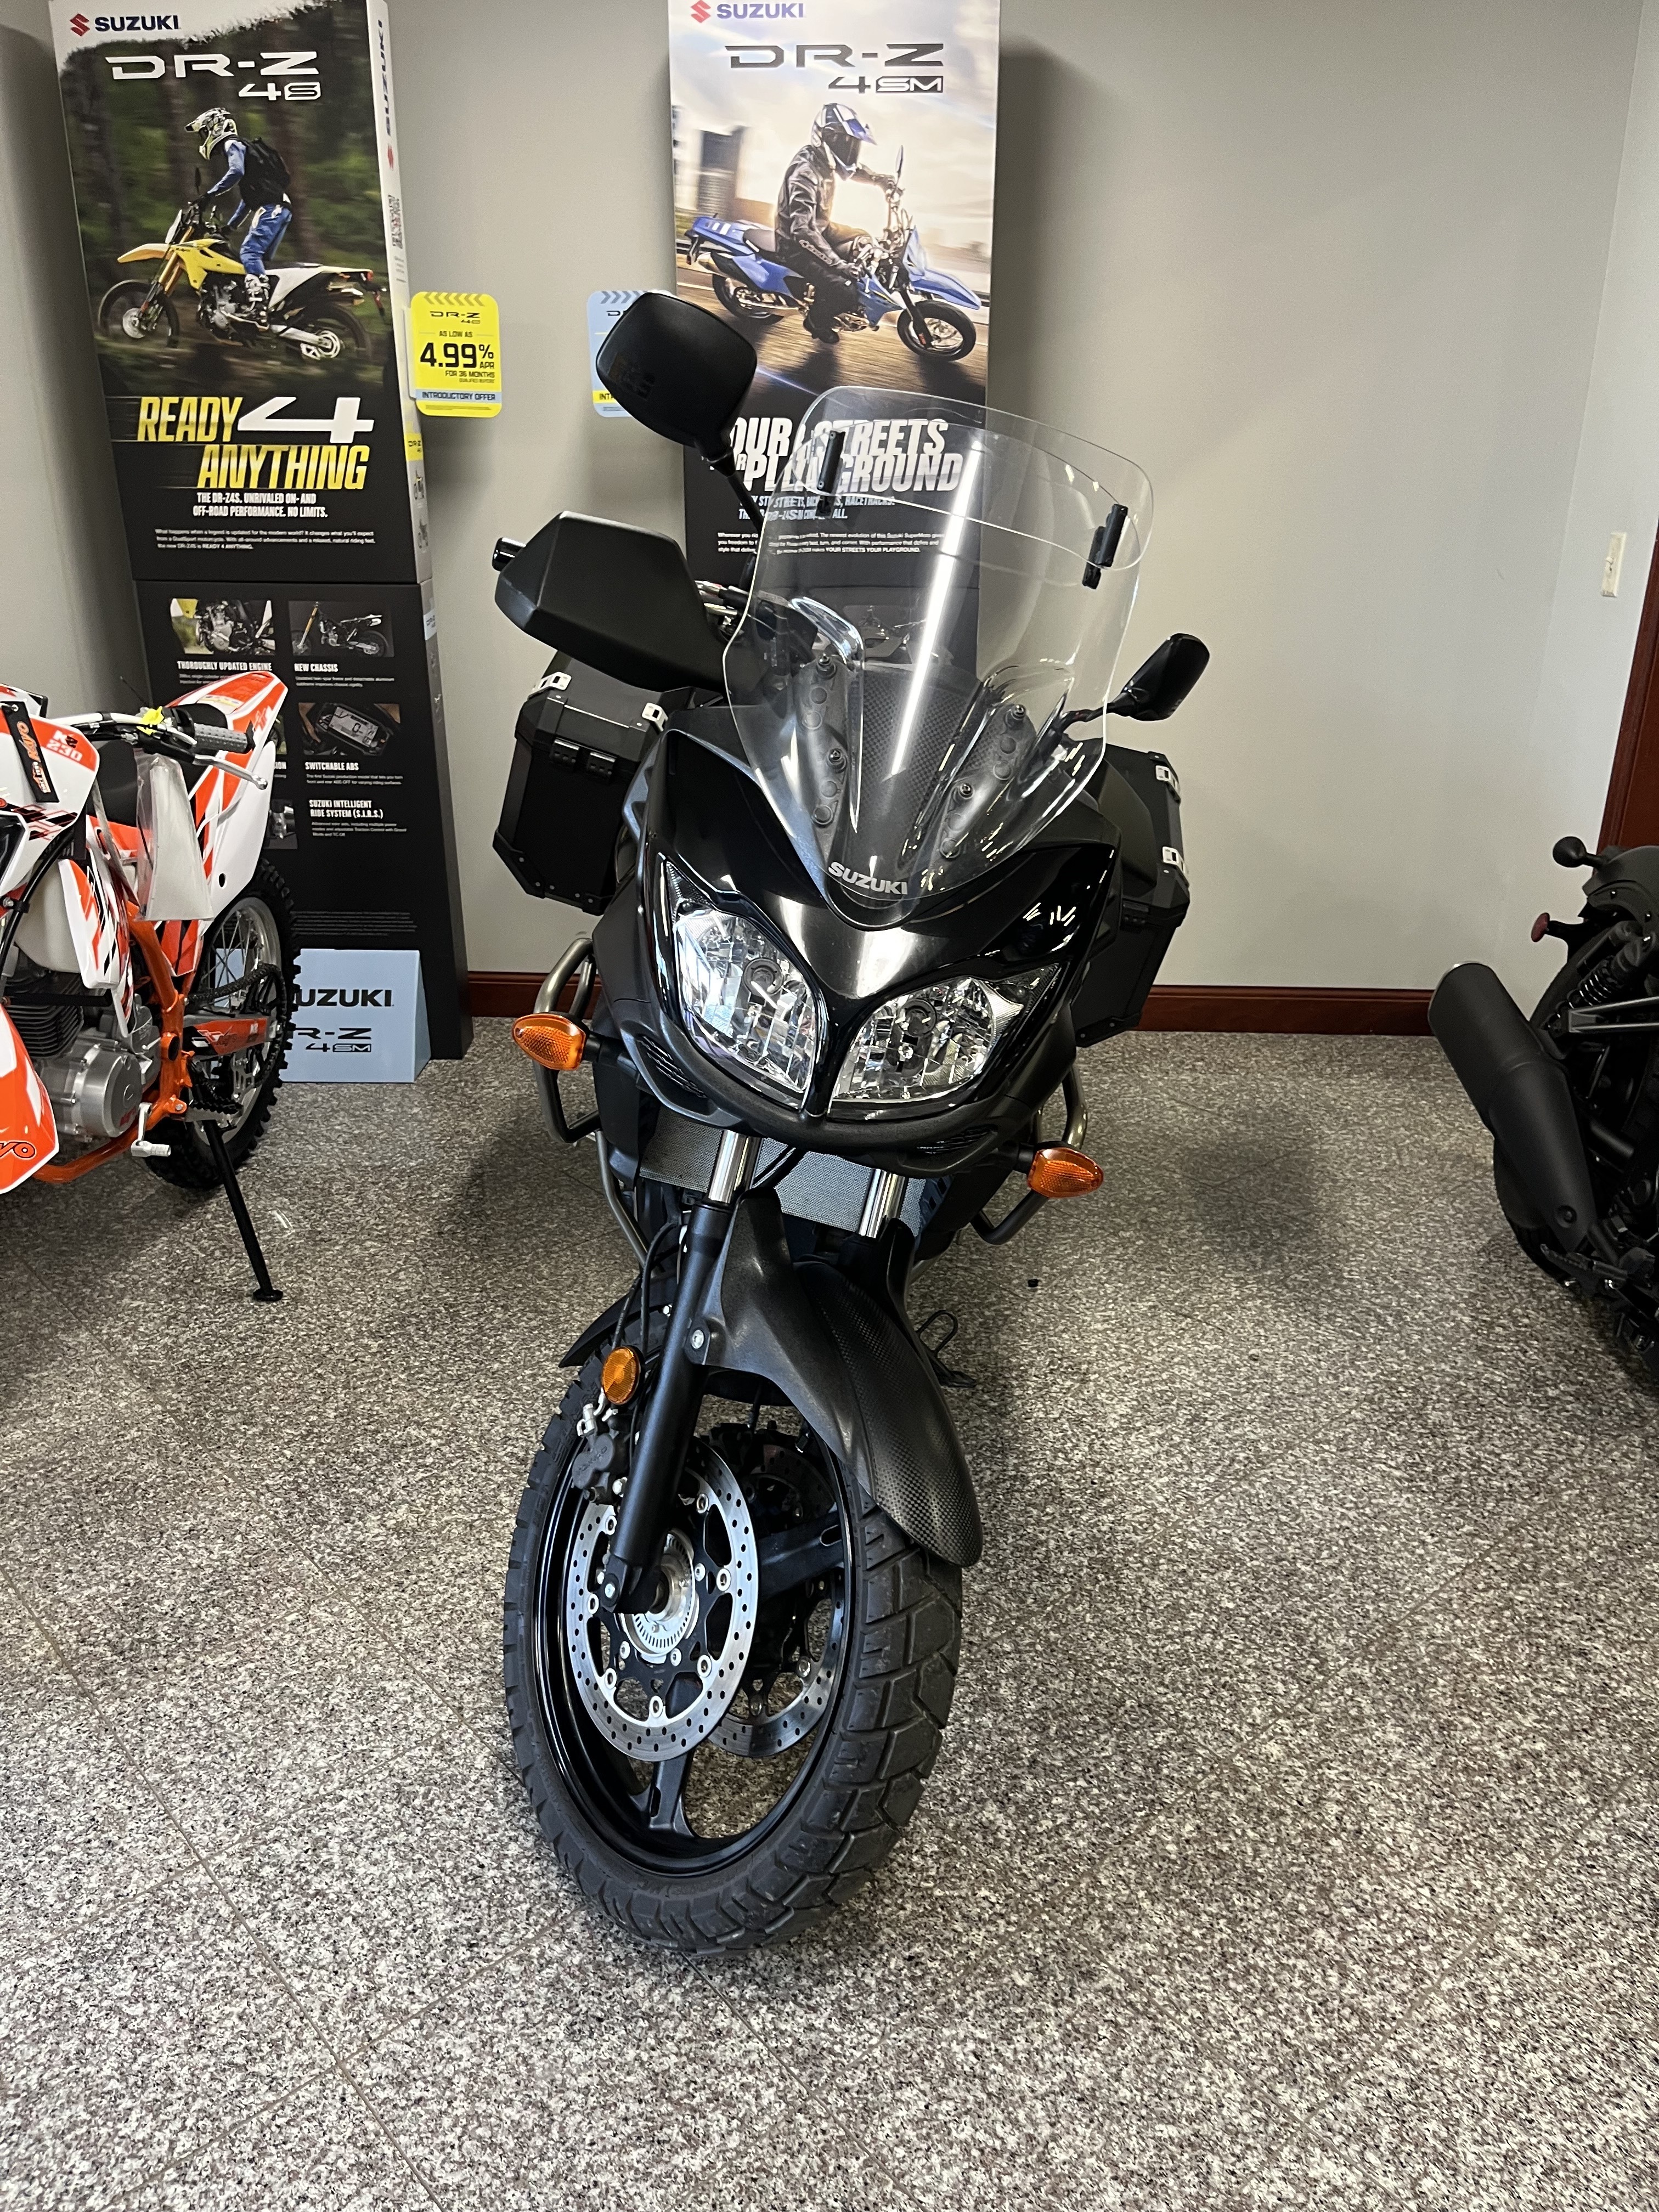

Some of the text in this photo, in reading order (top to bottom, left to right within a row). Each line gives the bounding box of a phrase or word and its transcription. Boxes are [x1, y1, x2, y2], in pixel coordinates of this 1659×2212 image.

[717, 3, 804, 19] SUZUKI
[94, 15, 179, 31] SUZUKI
[725, 43, 944, 69] DR-Z
[105, 52, 320, 80] DR-Z
[377, 19, 391, 137] SUZUKI
[828, 76, 944, 94] 4SM
[239, 82, 321, 101] 4S
[422, 392, 473, 400] INTRODUCTORY
[137, 396, 375, 443] READY 4
[730, 417, 793, 456] OUR
[197, 444, 370, 489] ANYTHING
[197, 493, 317, 504] THE DR-Z4S. UNRIVALED ON- AND
[193, 505, 329, 517] OFF-ROAD PERFORMANCE. NO LIMITS.
[177, 661, 272, 671] THOROUGHLY UPDATED ENGINE
[294, 663, 338, 673] NEW CHASSIS
[46, 739, 83, 762] 230
[305, 762, 359, 771] SWITCHABLE ABS
[309, 799, 372, 808] SUZUKI INTELLIGENT
[828, 861, 908, 895] SUZUKI
[295, 989, 392, 1007] UZUKI
[305, 1043, 372, 1053] 4SM
